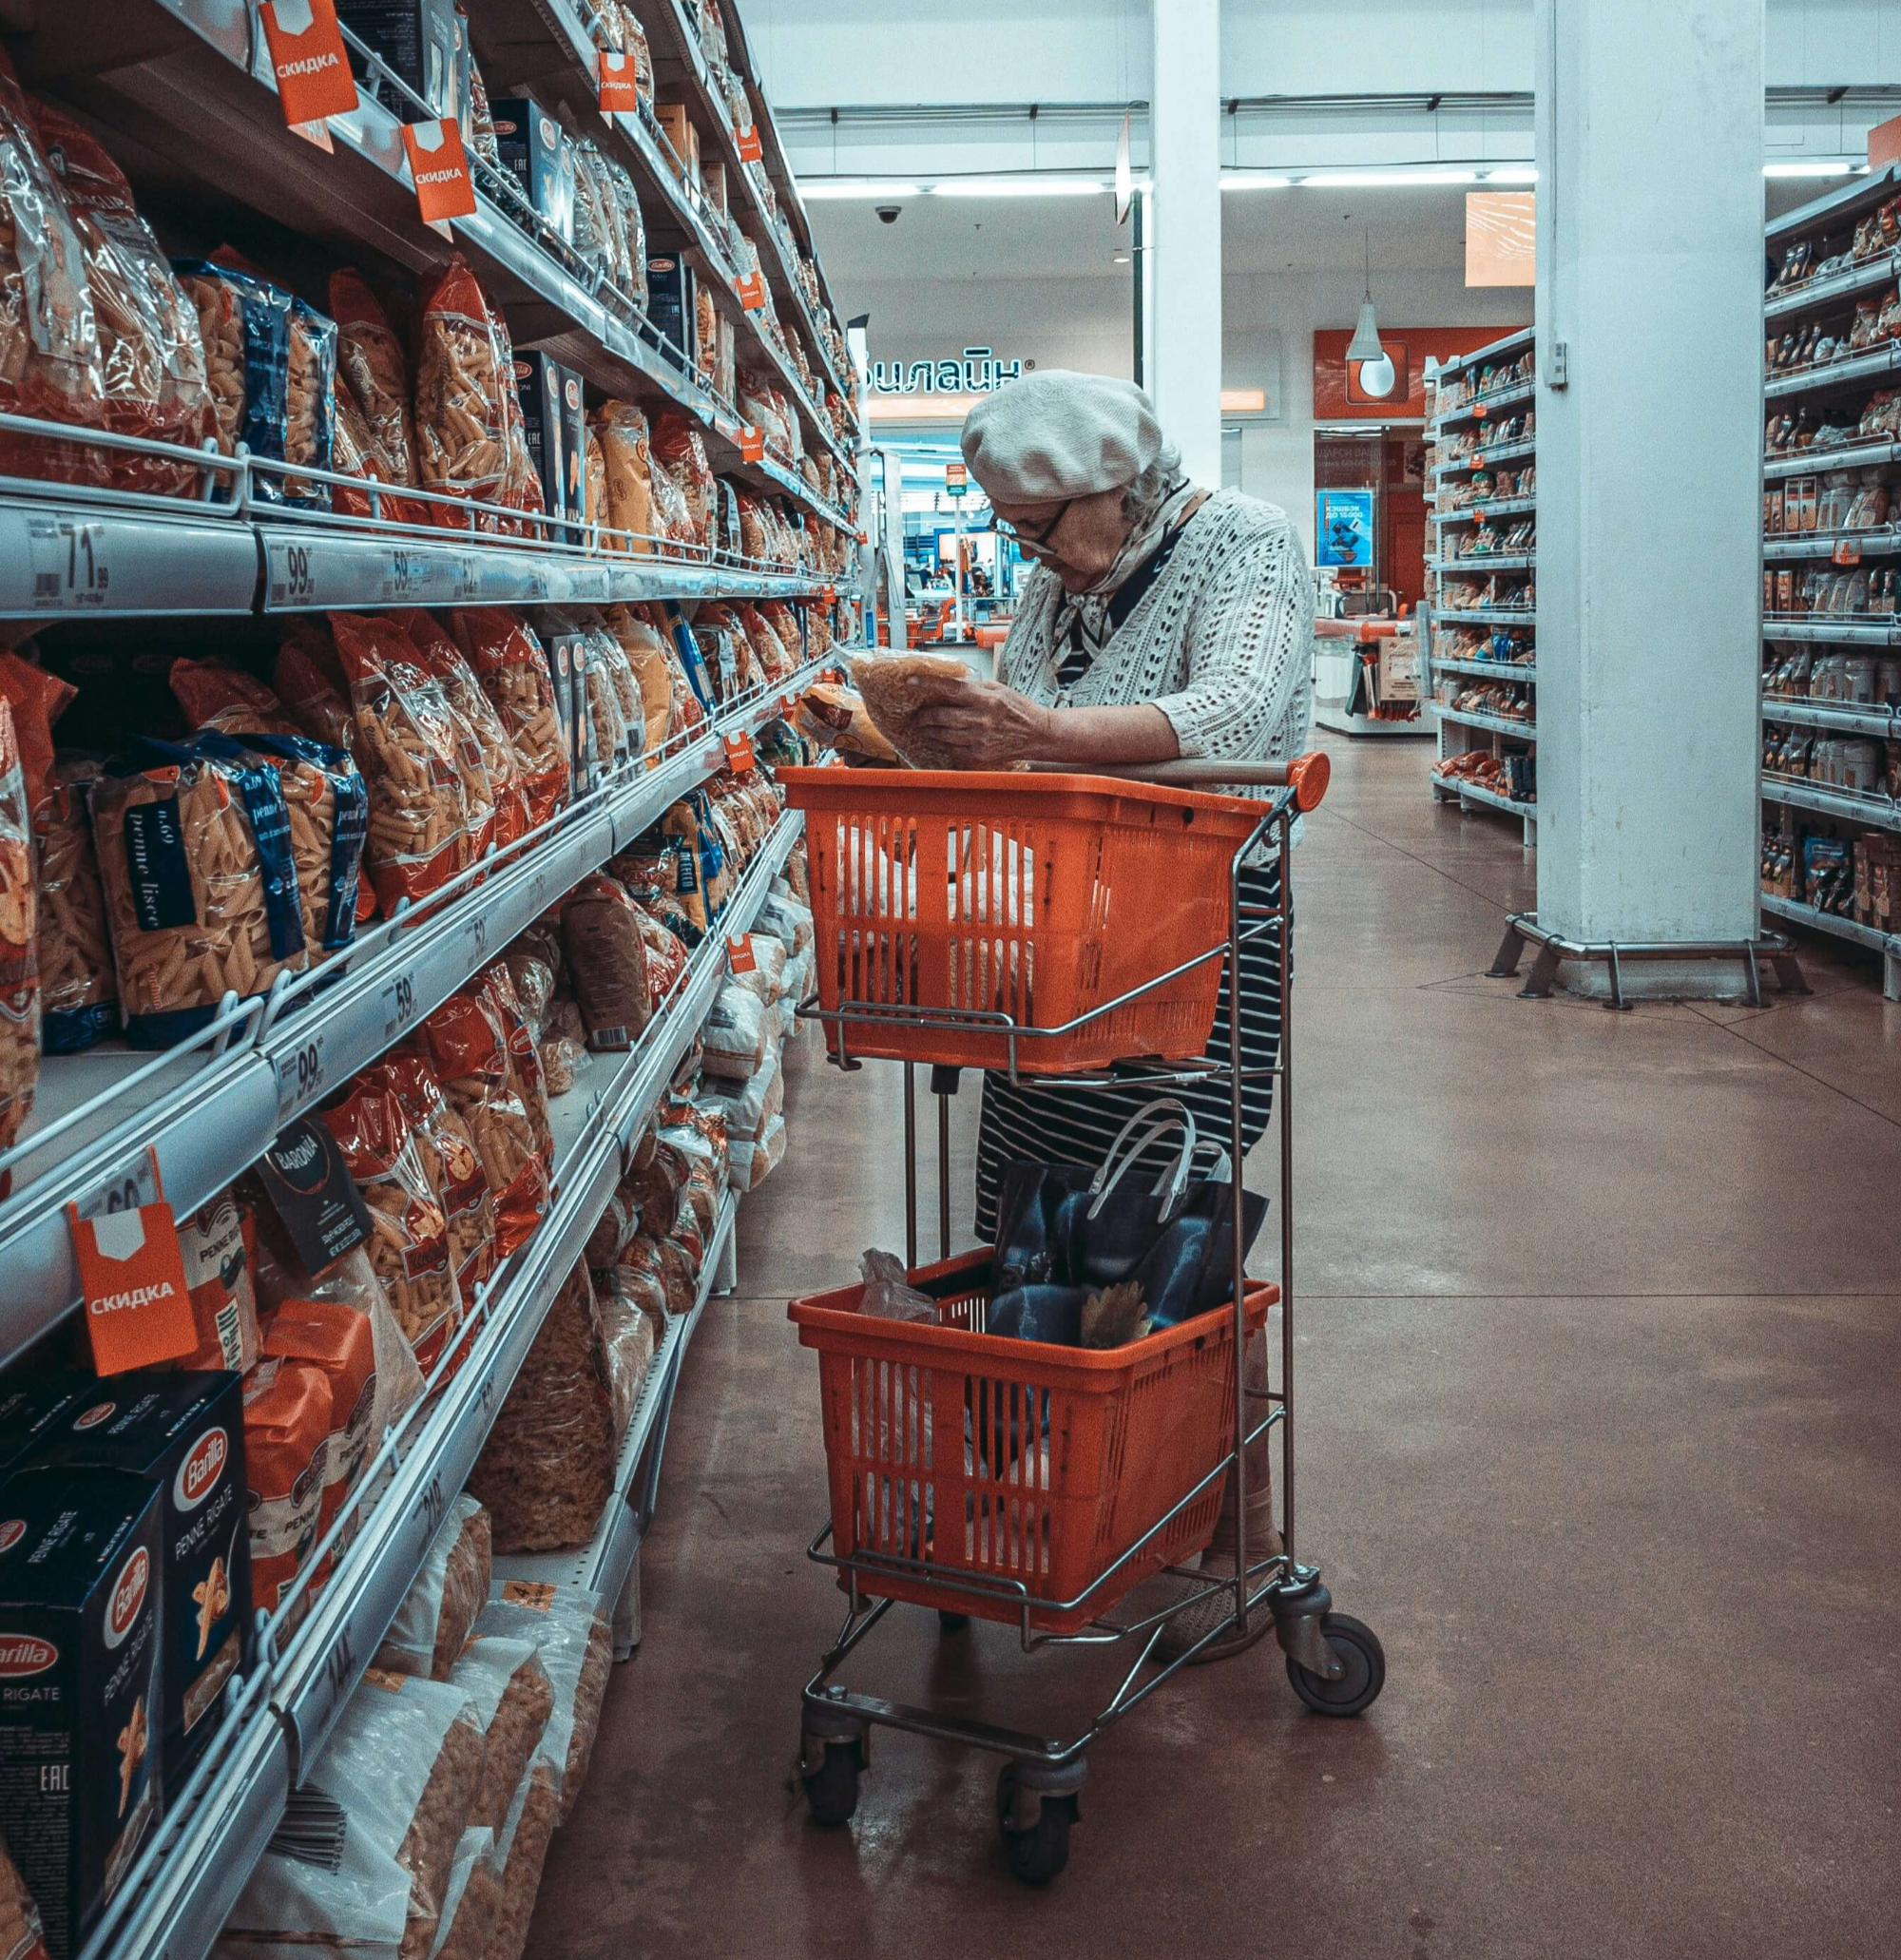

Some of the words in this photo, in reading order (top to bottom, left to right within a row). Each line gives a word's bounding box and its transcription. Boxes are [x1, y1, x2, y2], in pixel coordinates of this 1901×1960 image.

[276, 52, 339, 79] СКИДКА
[601, 82, 632, 90] СКИДКА
[415, 167, 463, 184] СКИДКА
[287, 546, 308, 595] 99
[157, 810, 175, 845] n.69
[129, 813, 149, 874] penne
[142, 882, 160, 928] lisce
[394, 976, 412, 1024] 59
[298, 1043, 318, 1094] 99
[200, 1235, 229, 1263] PENNE
[90, 1281, 175, 1316] СКИДКА
[187, 1436, 225, 1493] Barilla
[175, 1518, 204, 1561] PENNE
[206, 1483, 233, 1528] RIGATE
[115, 1558, 146, 1626] Barilla
[0, 1643, 48, 1663] arilla
[4, 1687, 61, 1701] RIGATE
[41, 1764, 70, 1791] EAC
